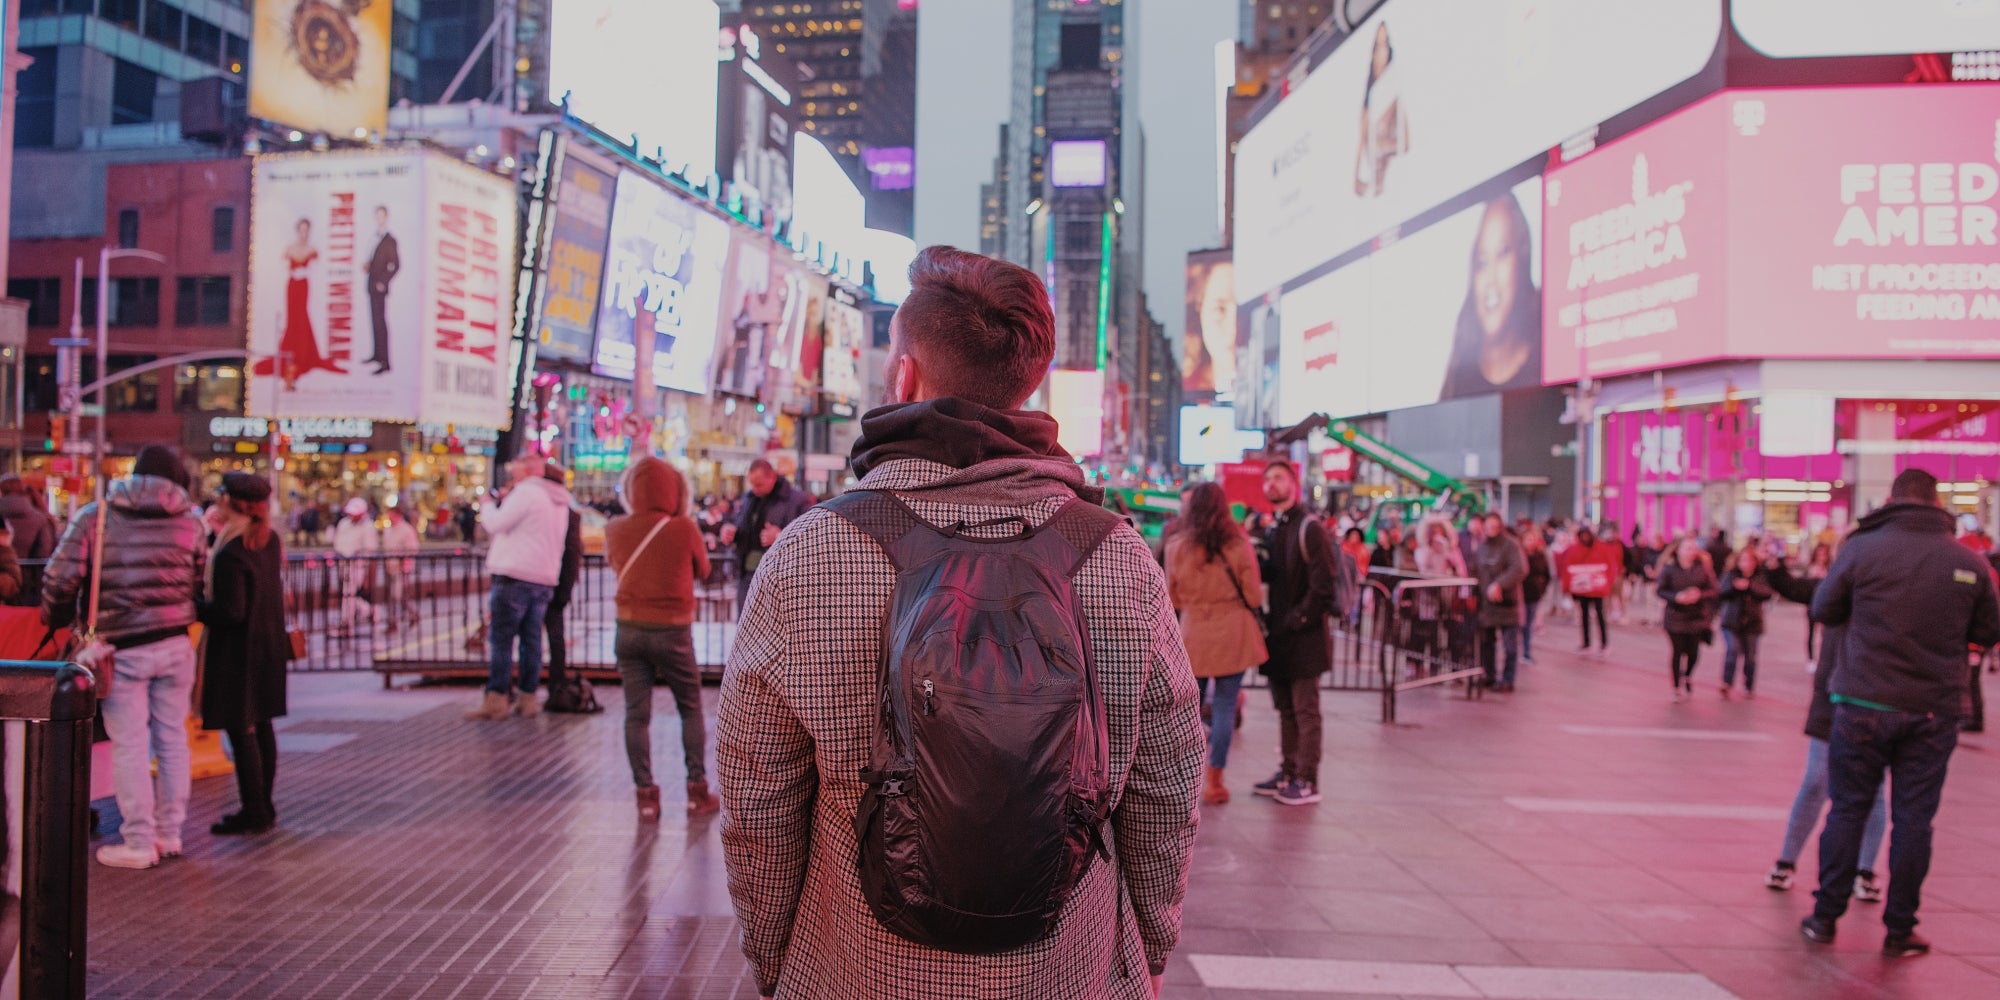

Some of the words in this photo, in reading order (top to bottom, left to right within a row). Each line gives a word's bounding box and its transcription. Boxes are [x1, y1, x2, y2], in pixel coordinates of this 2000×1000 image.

[1841, 163, 1999, 204] FEED
[329, 192, 354, 263] PRETTY
[1570, 184, 1686, 256] FEEDING
[1833, 205, 1997, 247] AMER
[436, 203, 467, 352] WOMAN
[470, 209, 497, 363] PRETTY
[1567, 224, 1686, 290] AMERICA
[1812, 264, 1865, 291] NET
[1868, 263, 2000, 290] PROCEEDS
[328, 282, 352, 361] WOMAN
[1856, 293, 1966, 320] FEEDING
[209, 416, 268, 437] GIFTS
[279, 417, 373, 437] LUGGAGE
